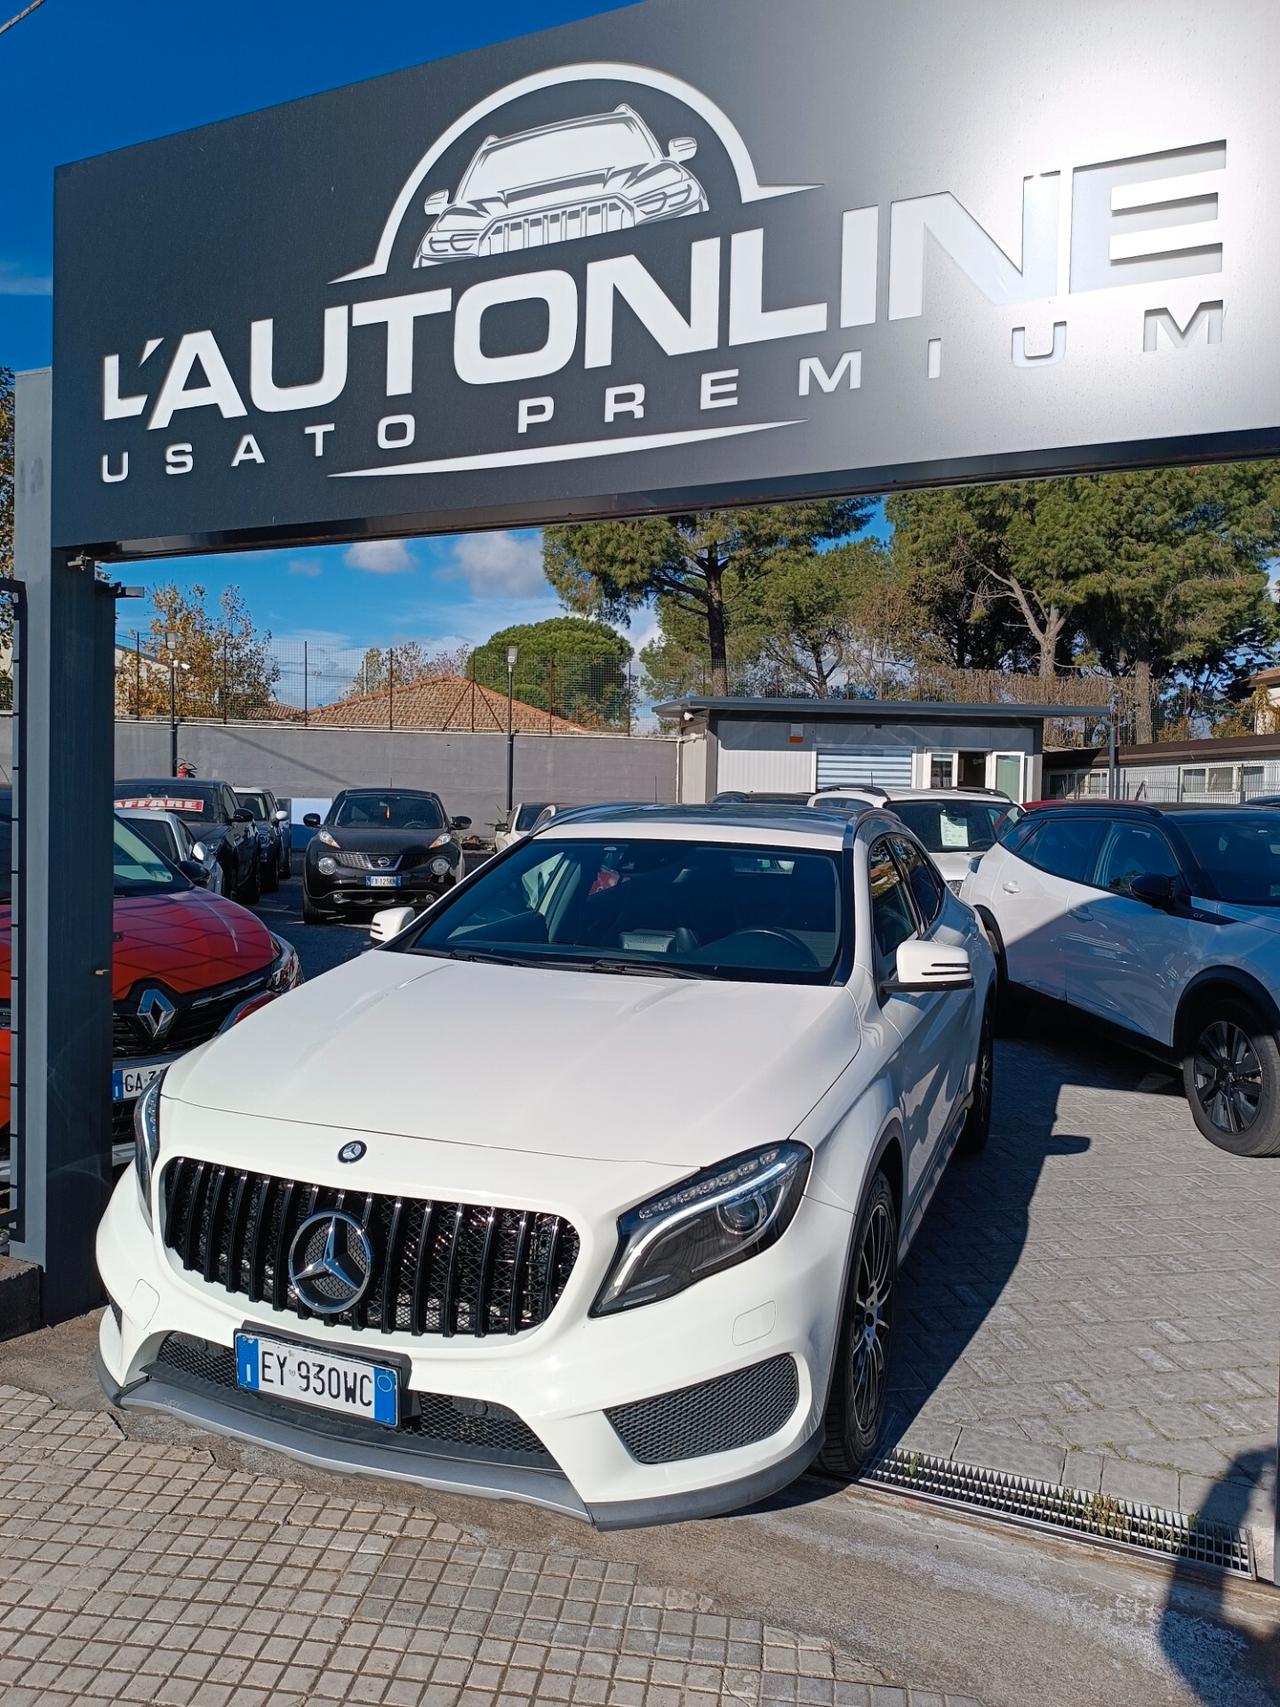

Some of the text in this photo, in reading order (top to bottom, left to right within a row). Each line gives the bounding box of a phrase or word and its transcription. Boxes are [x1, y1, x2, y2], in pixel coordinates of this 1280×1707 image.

[101, 299, 1224, 483] USATO PREMIUM
[102, 139, 1227, 430] L'AUTONLINE
